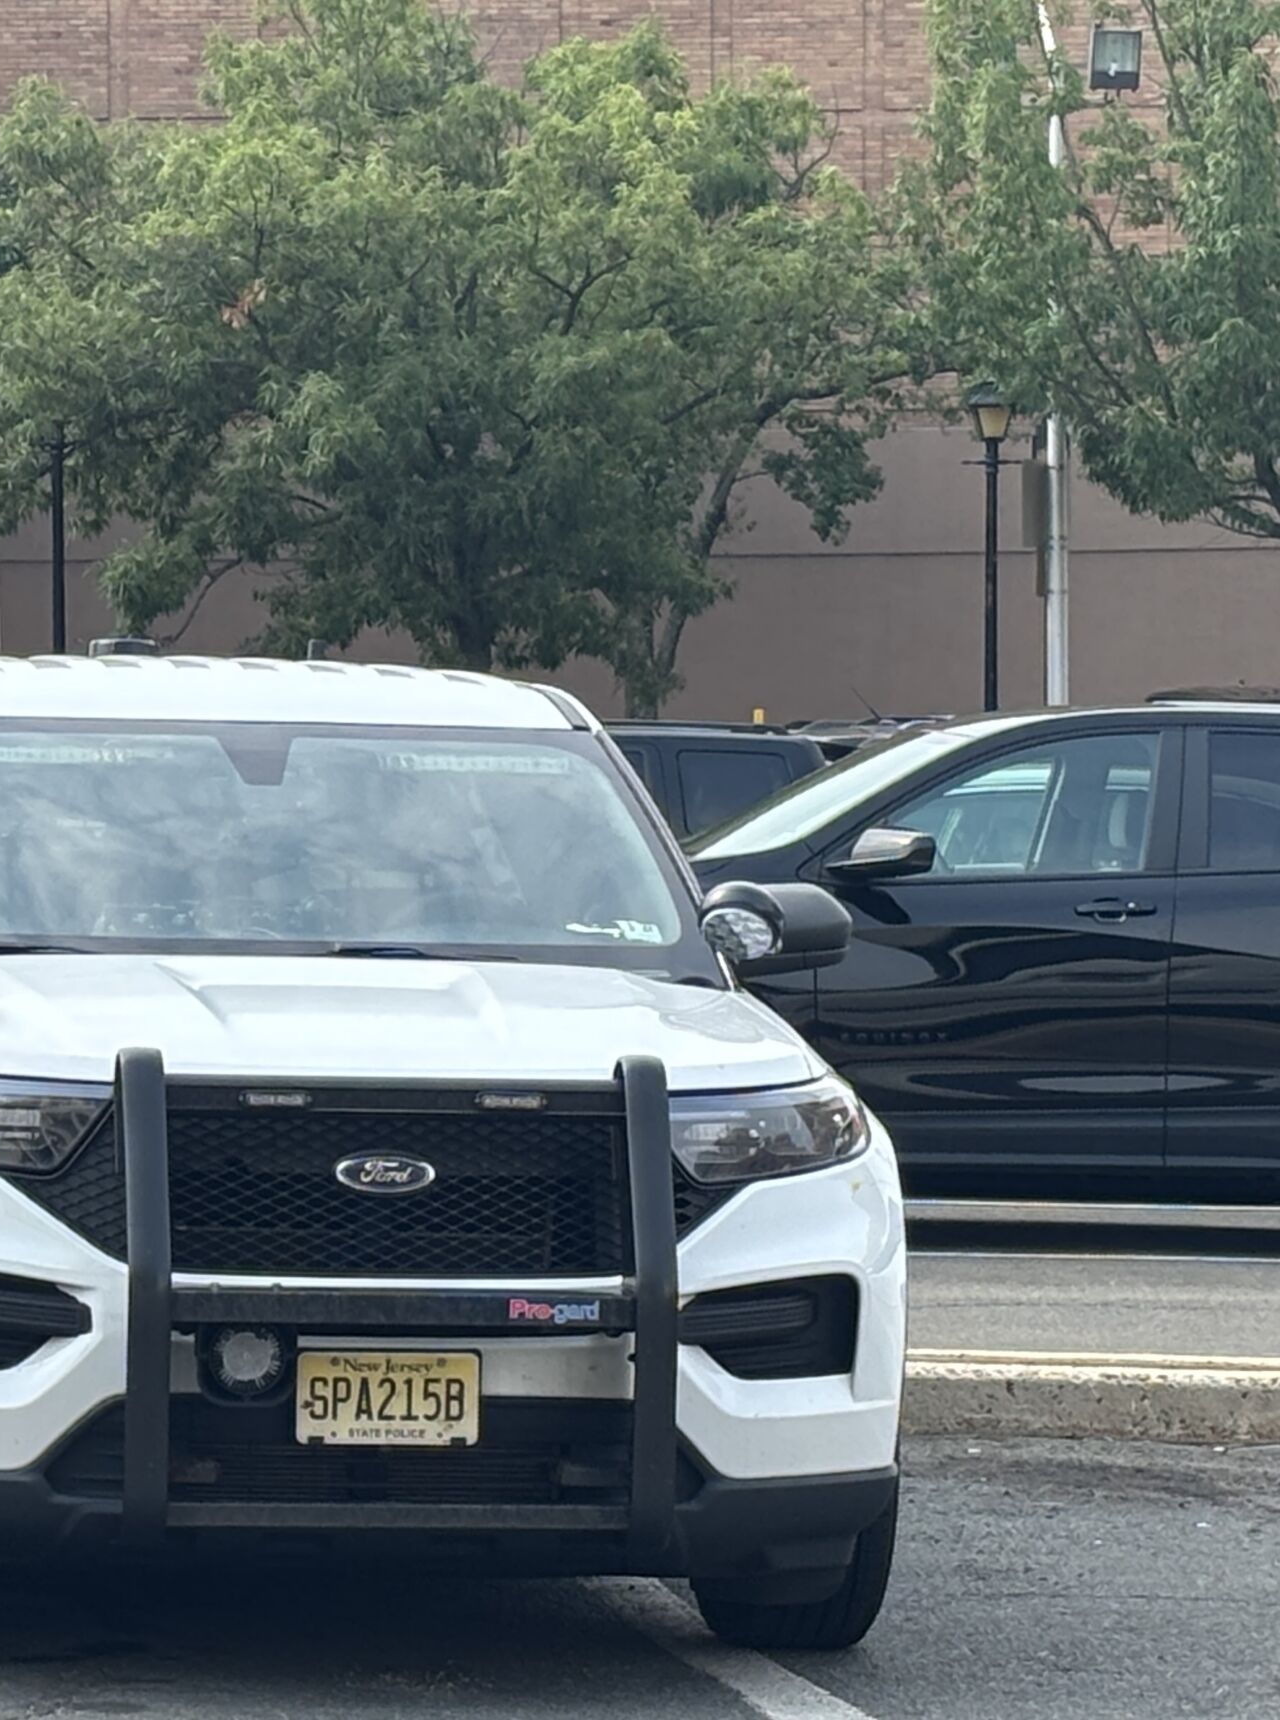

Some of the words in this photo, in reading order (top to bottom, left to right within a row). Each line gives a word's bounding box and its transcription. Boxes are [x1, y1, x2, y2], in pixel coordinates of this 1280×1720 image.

[361, 1160, 413, 1183] Ford
[508, 1299, 600, 1325] Pro-gard
[343, 1358, 381, 1373] New
[382, 1358, 434, 1375] Jersey
[308, 1376, 466, 1422] SPA215B
[348, 1427, 381, 1438] STATE
[384, 1428, 427, 1439] POLICE
